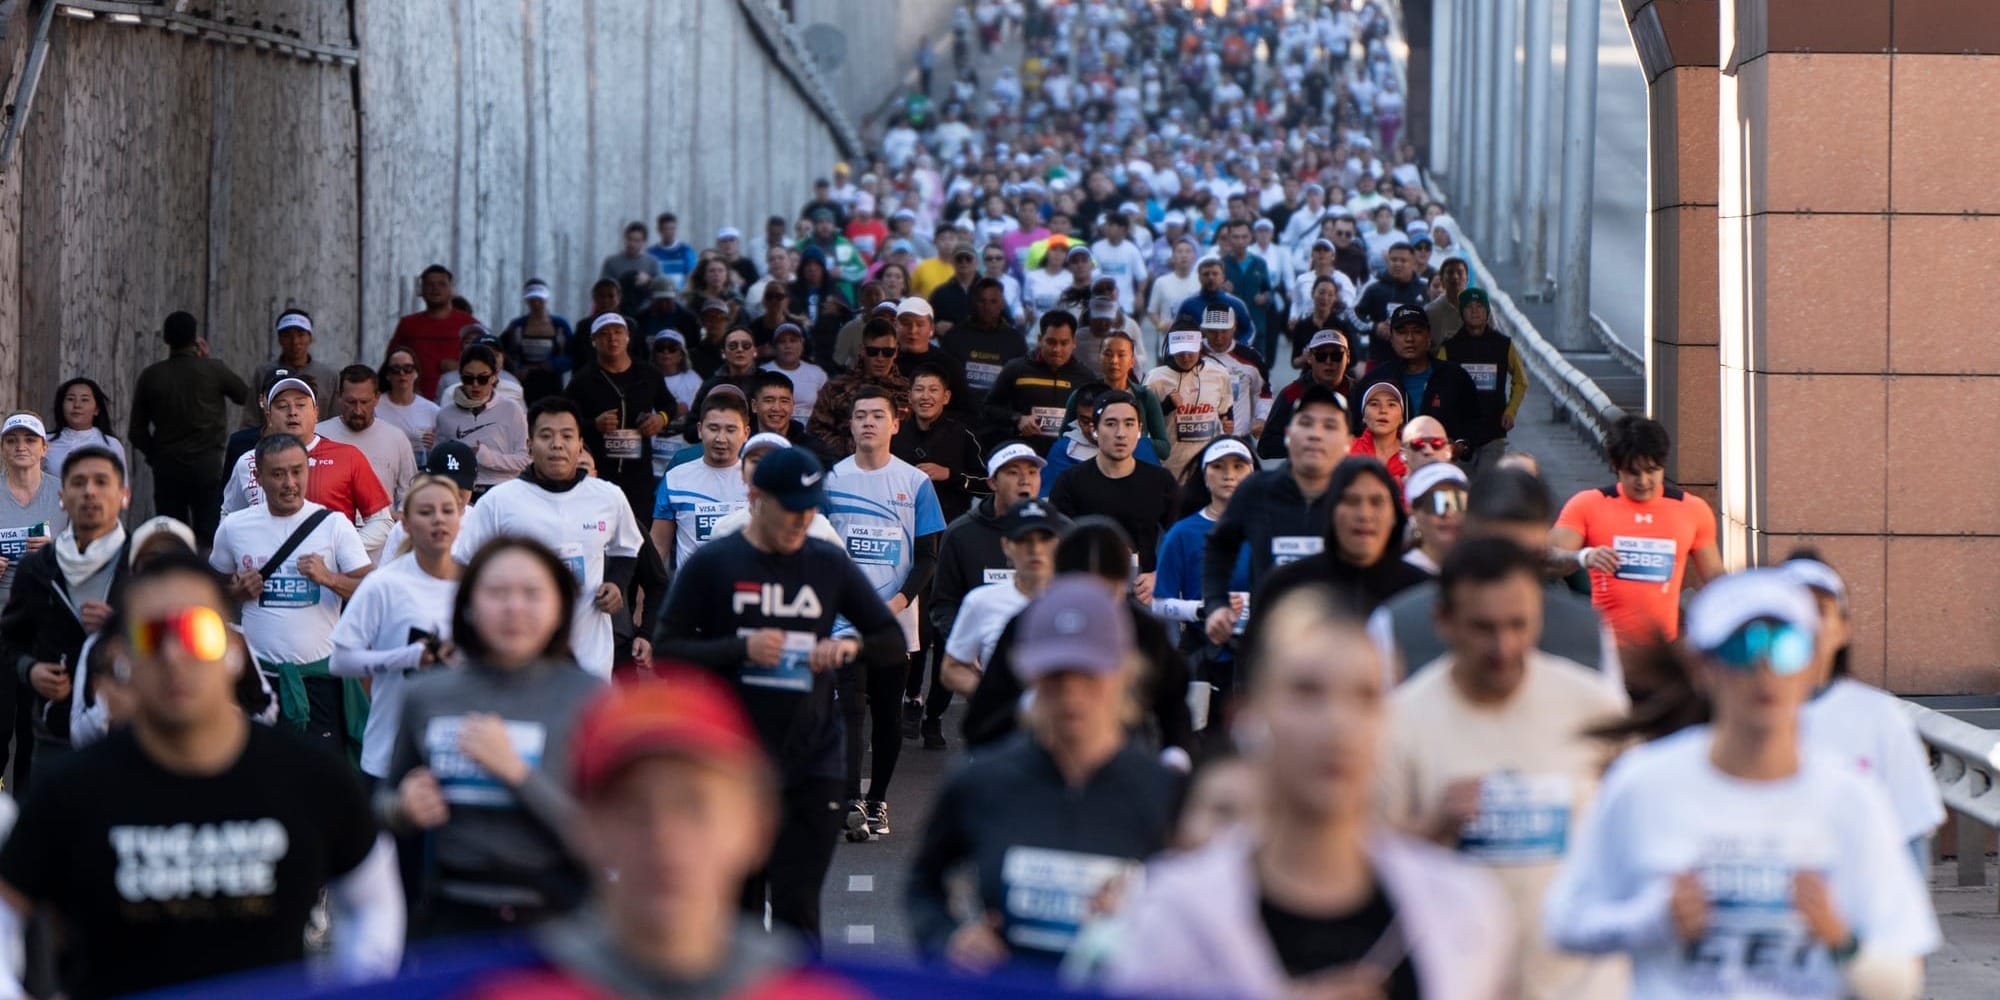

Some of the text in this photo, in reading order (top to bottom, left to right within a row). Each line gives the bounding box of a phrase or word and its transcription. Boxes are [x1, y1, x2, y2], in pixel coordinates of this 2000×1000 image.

[9, 418, 22, 426] VISA
[447, 454, 460, 470] LA
[699, 516, 718, 528] 58
[0, 531, 18, 539] VISA
[852, 527, 869, 535] VISA
[850, 539, 889, 553] 5917
[1616, 552, 1665, 567] 5282
[263, 579, 307, 592] 5122
[733, 581, 823, 619] FILA
[114, 861, 277, 903] COFFEE
